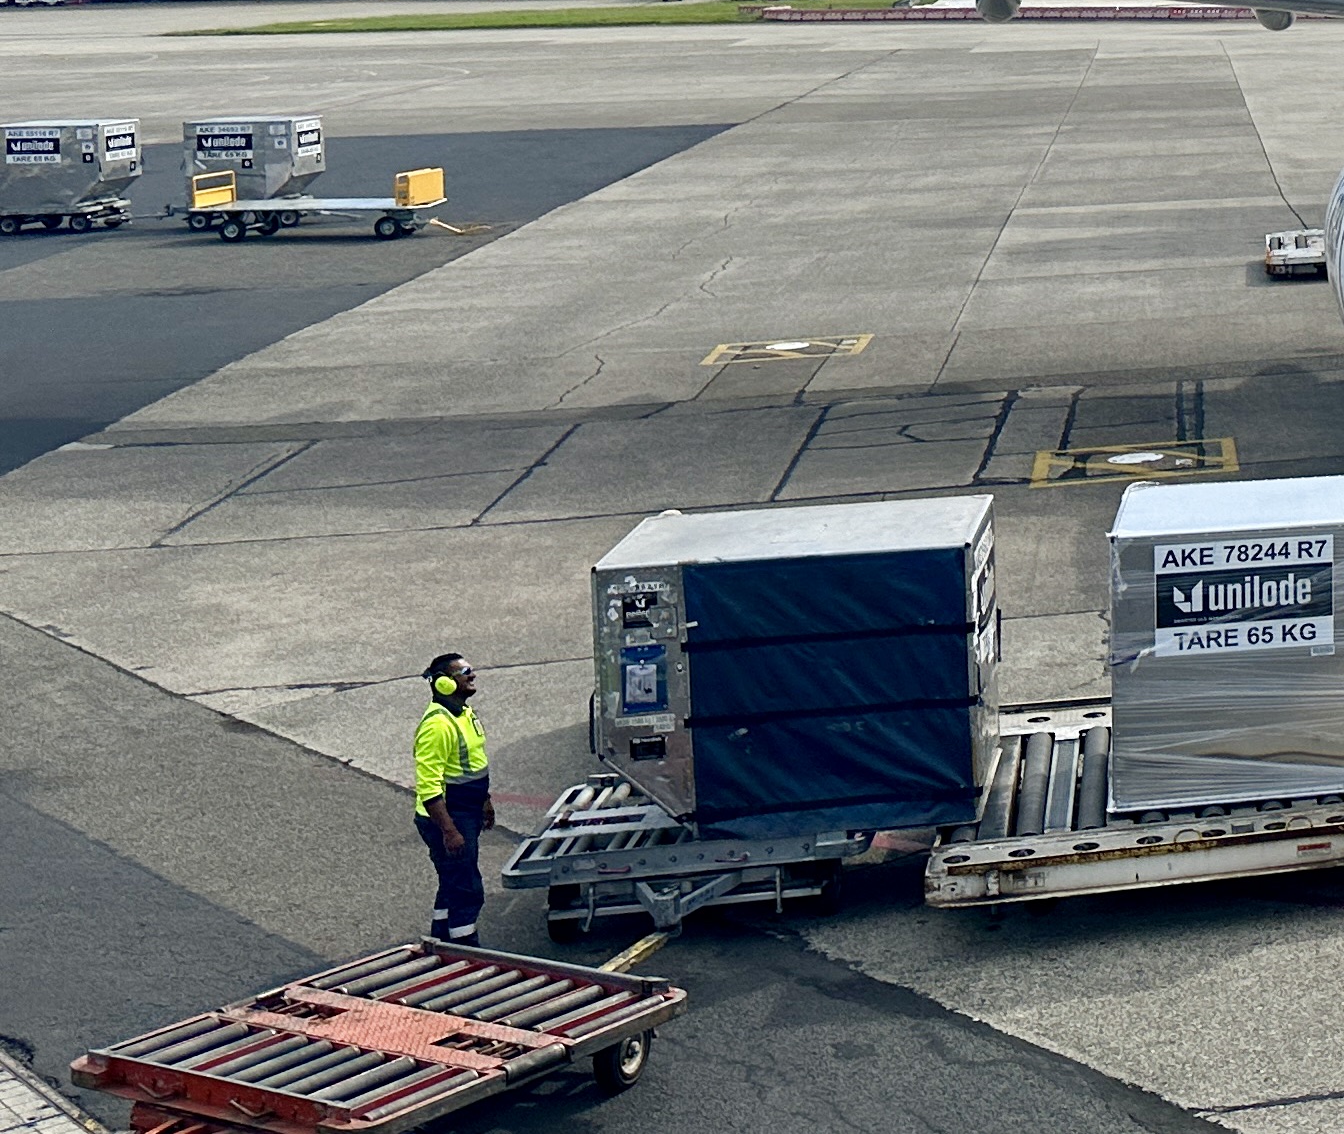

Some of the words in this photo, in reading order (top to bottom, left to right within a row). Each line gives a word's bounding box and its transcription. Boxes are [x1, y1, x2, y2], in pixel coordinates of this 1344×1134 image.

[1162, 547, 1214, 568] AKE
[1224, 541, 1291, 563] 78244
[1297, 540, 1327, 559] R7
[1208, 573, 1312, 611] unilode
[1174, 628, 1239, 650] TARE
[1247, 626, 1273, 645] 65
[1282, 623, 1317, 642] KG
